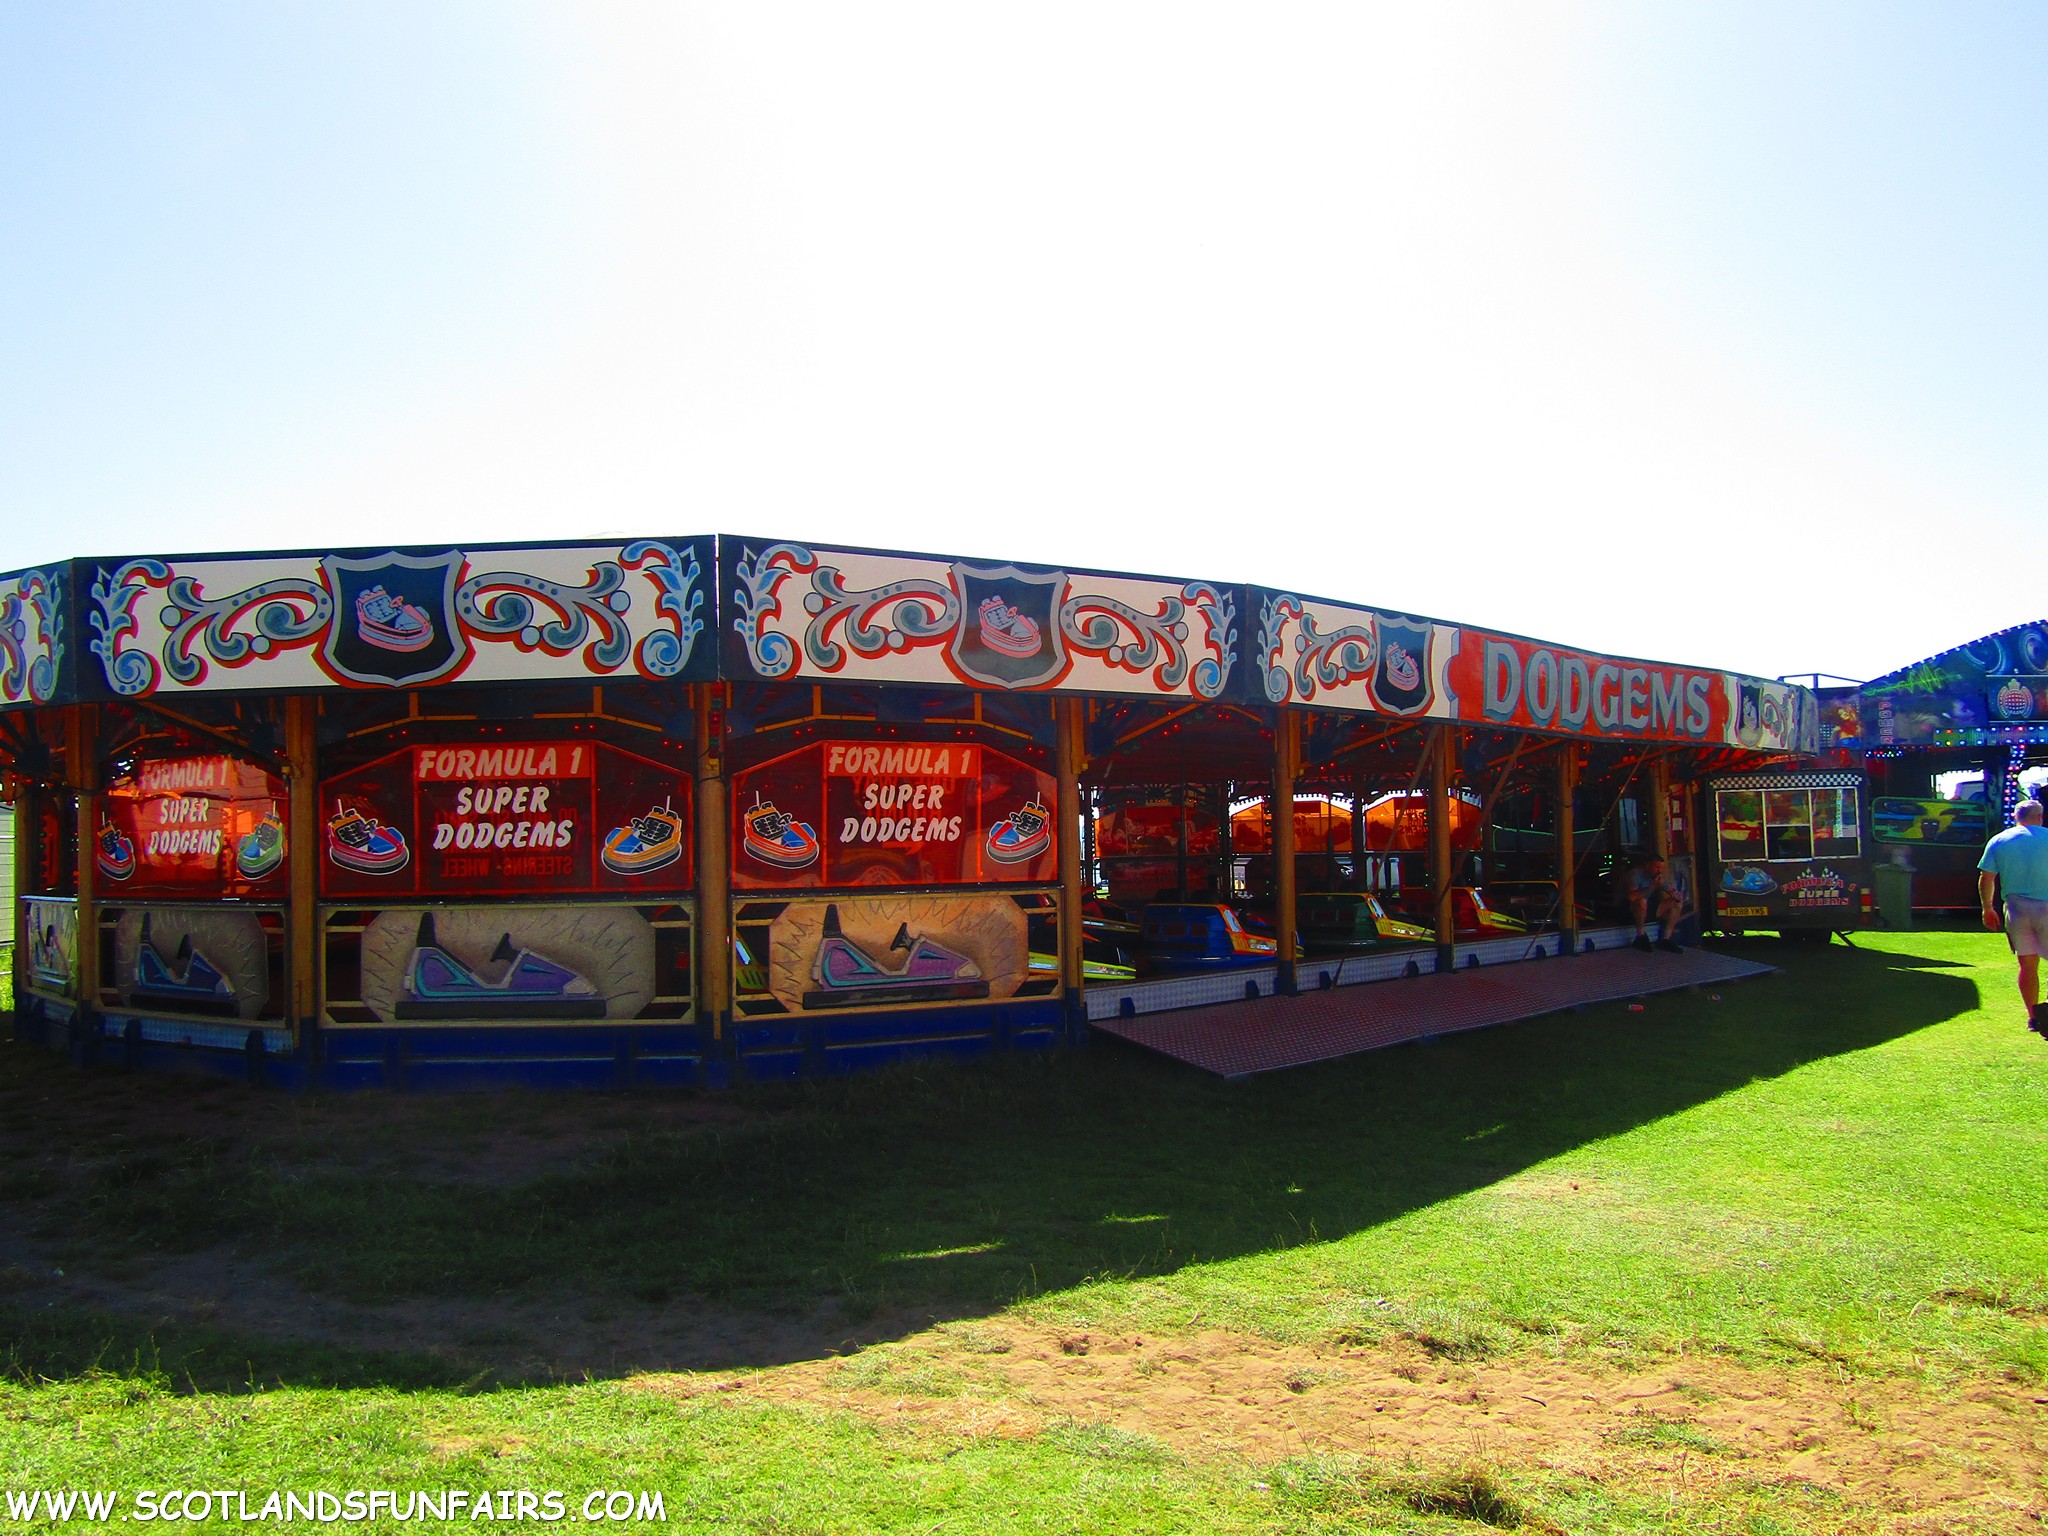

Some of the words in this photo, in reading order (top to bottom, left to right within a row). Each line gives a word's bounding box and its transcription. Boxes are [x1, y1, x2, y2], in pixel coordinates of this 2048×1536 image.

[1483, 638, 1710, 739] DODGEMS
[141, 760, 214, 790] FORMULA
[220, 759, 229, 786] 1
[419, 748, 557, 779] FORMULA
[570, 747, 583, 774] 1
[829, 746, 949, 775] FORMULA
[960, 749, 971, 774] 1
[160, 797, 210, 824] SUPER
[457, 786, 550, 815] SUPER
[864, 783, 944, 810] SUPER
[149, 829, 223, 855] DODGEMS
[433, 819, 573, 850] DODGEMS
[840, 816, 962, 843] DODGEMS
[1781, 877, 1844, 894] FORMULA
[1789, 898, 1849, 907] DODGEMS
